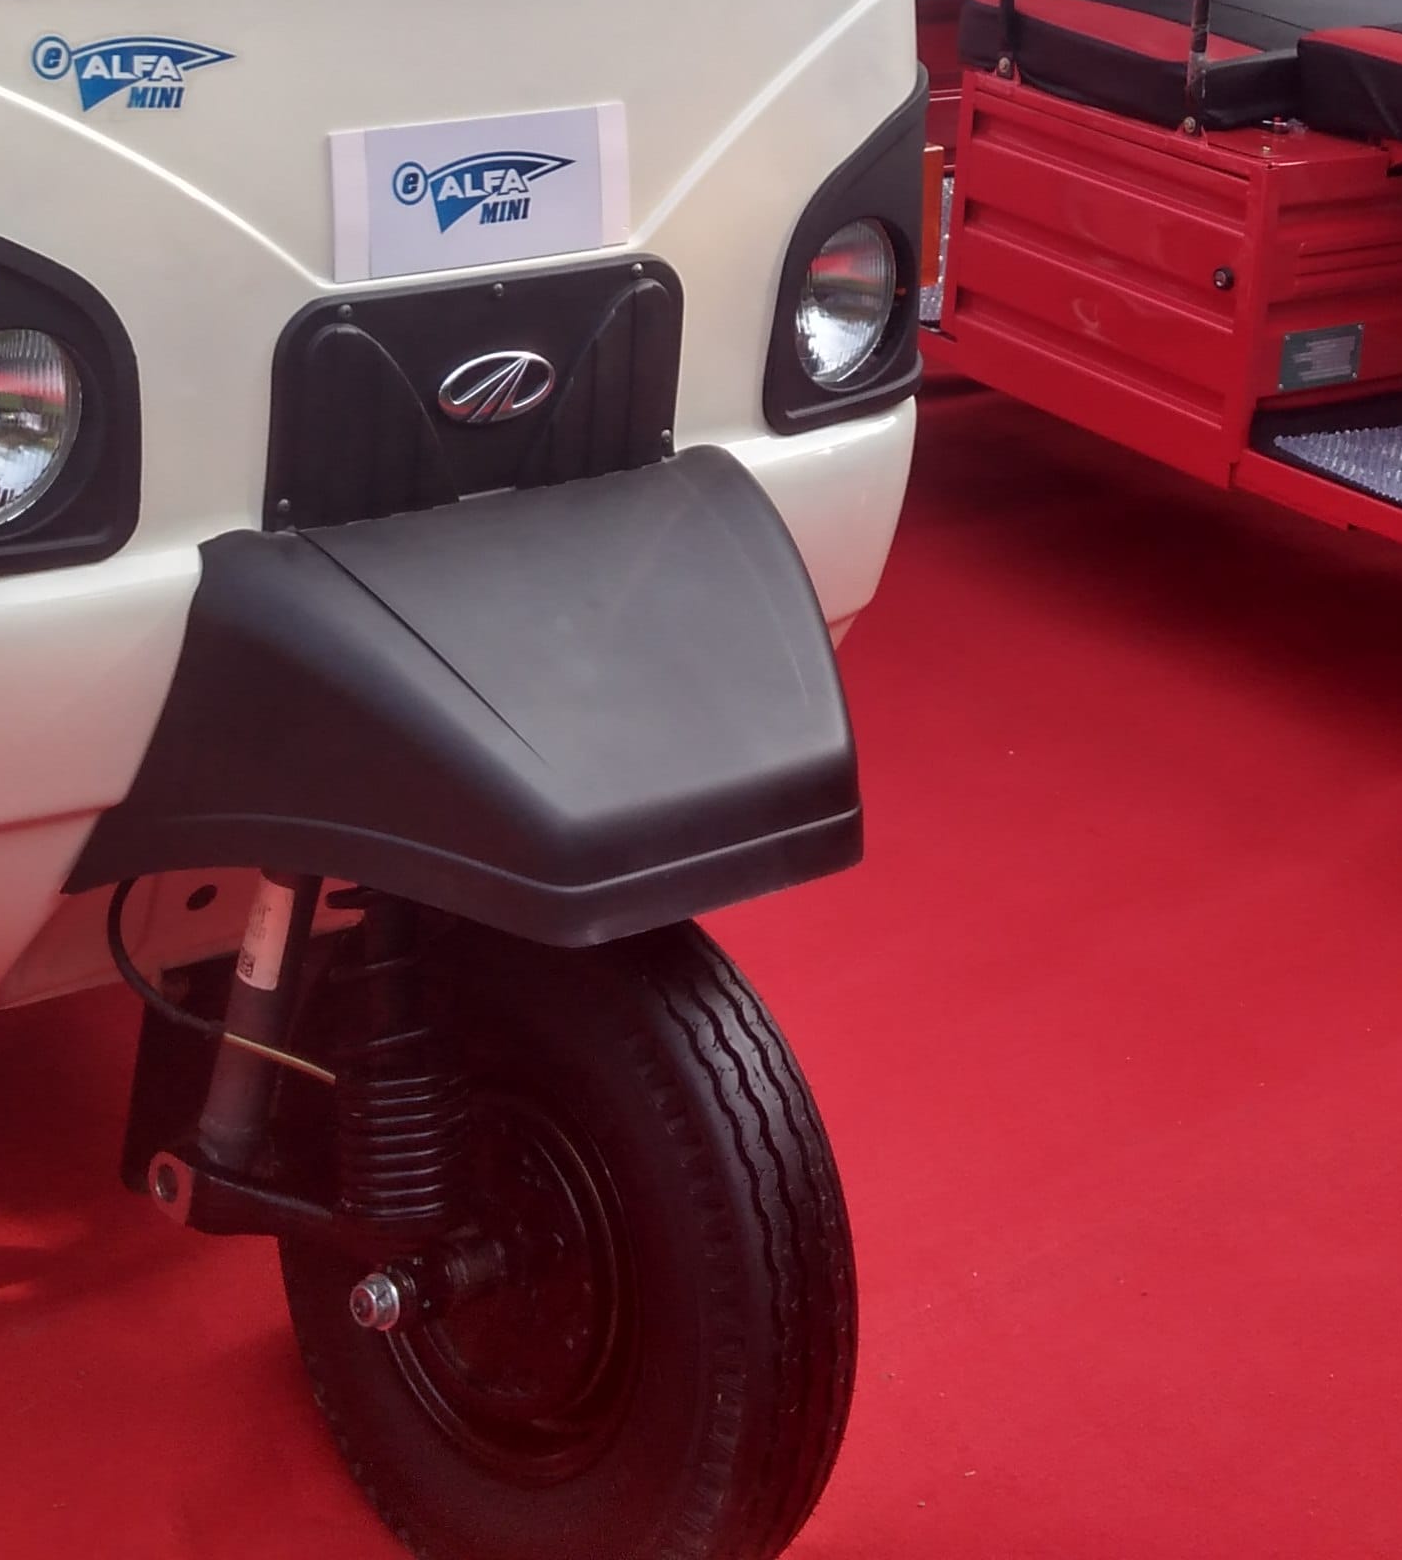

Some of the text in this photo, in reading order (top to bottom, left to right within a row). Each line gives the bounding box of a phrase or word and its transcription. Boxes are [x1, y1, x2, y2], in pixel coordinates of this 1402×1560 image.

[82, 55, 182, 81] ALFA
[127, 87, 184, 108] MINI
[437, 168, 529, 201] ALFA
[480, 197, 530, 224] MINI
